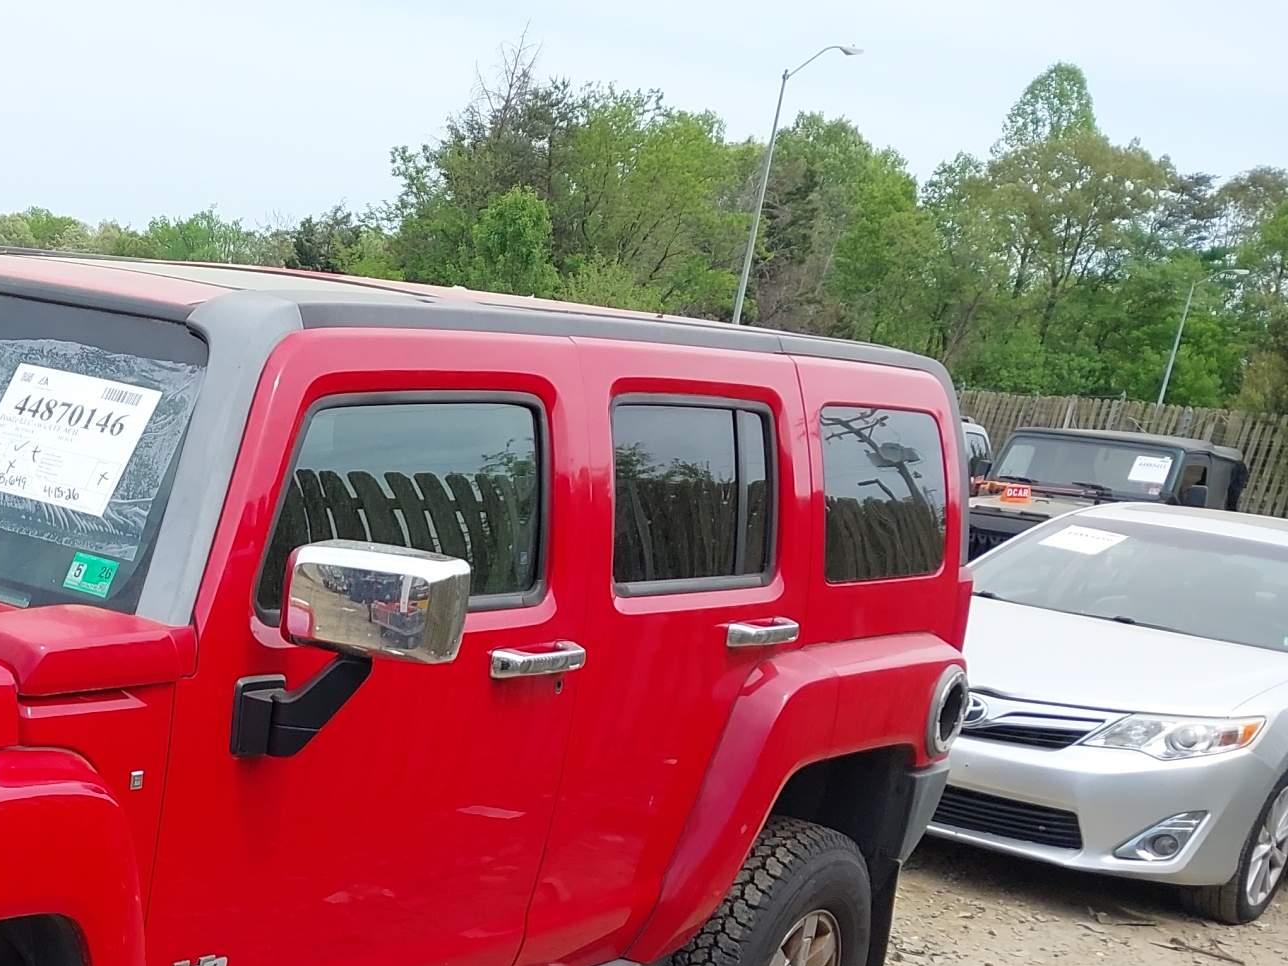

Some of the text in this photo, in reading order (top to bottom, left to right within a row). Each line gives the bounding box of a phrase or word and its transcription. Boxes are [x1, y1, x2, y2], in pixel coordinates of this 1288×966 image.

[14, 394, 131, 437] 44870146
[73, 563, 113, 580] 5 26
